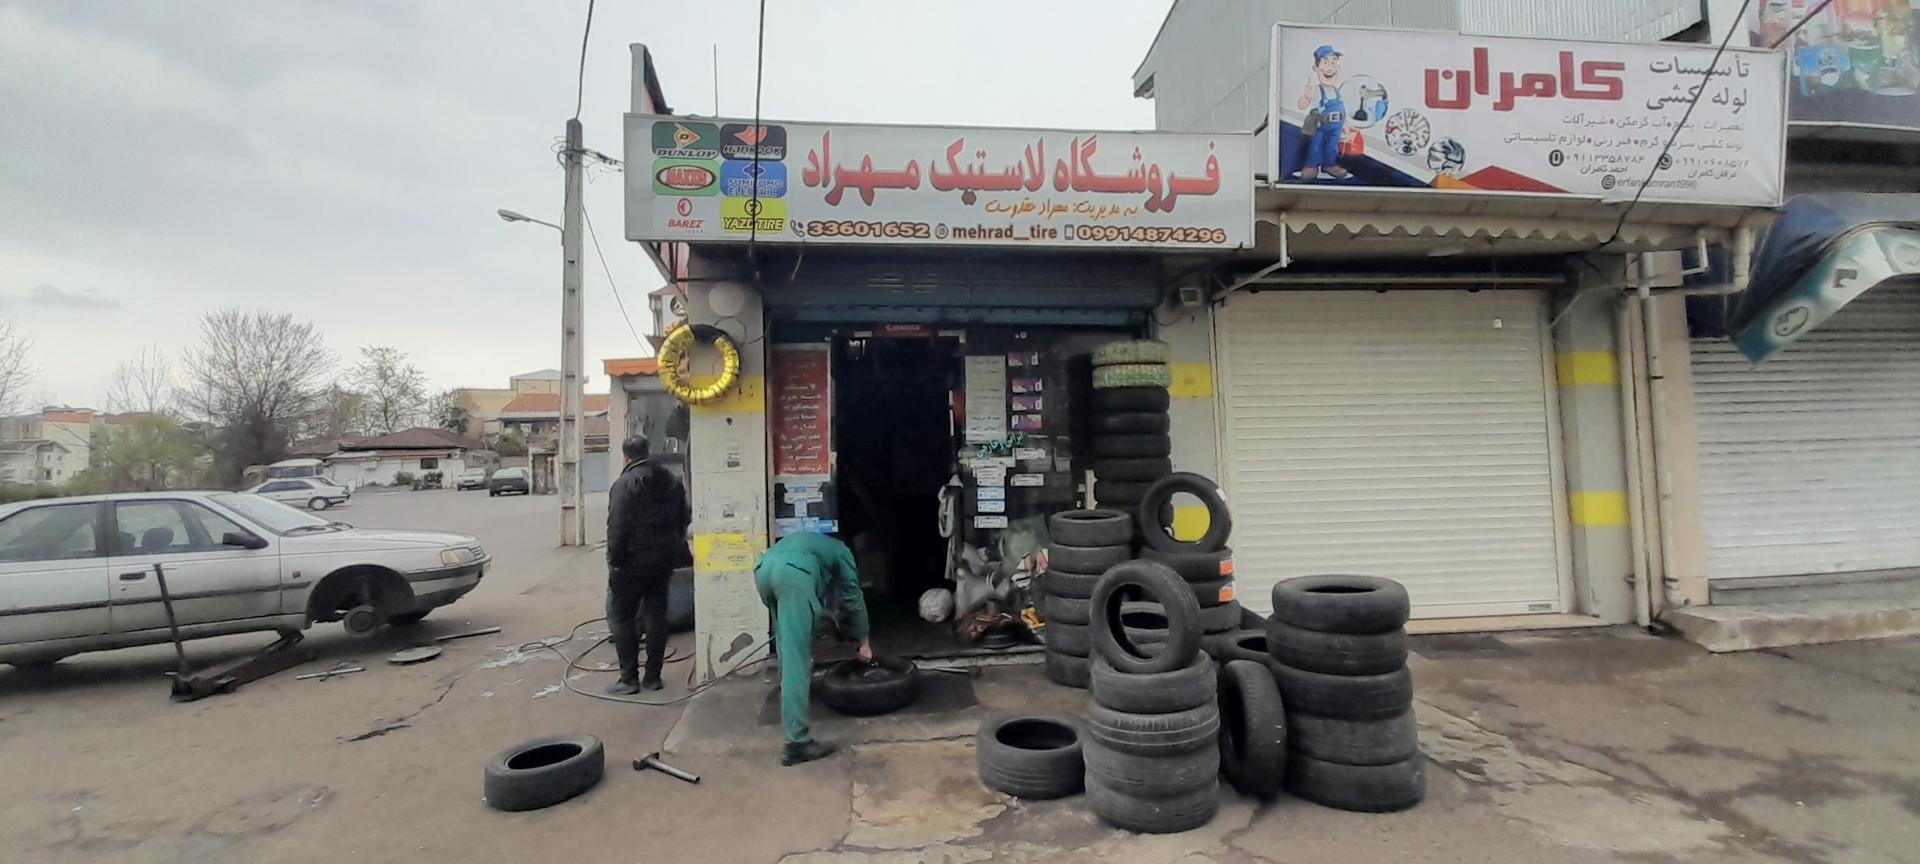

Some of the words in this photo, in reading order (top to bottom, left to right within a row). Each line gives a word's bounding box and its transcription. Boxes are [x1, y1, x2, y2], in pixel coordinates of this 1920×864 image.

[1424, 46, 1626, 112] کامران
[1646, 83, 1700, 110] کشی
[1712, 86, 1748, 114] لوله
[1616, 114, 1649, 128] گرمکن
[1671, 118, 1695, 132] پکج
[1558, 132, 1586, 146] لوازم
[1640, 136, 1659, 149] گرم
[656, 149, 717, 159] DUNLOP
[802, 129, 921, 207] مهراد
[928, 135, 1045, 207] لاستیک
[1053, 133, 1221, 214] فروشگاه
[727, 177, 784, 188] SUMIOMO
[727, 187, 778, 197] ELECRIC
[1123, 205, 1139, 217] به
[667, 219, 705, 229] BAREZ
[756, 218, 784, 231] TIRE
[807, 220, 931, 239] 33601652
[1077, 224, 1227, 243] 09914874296
